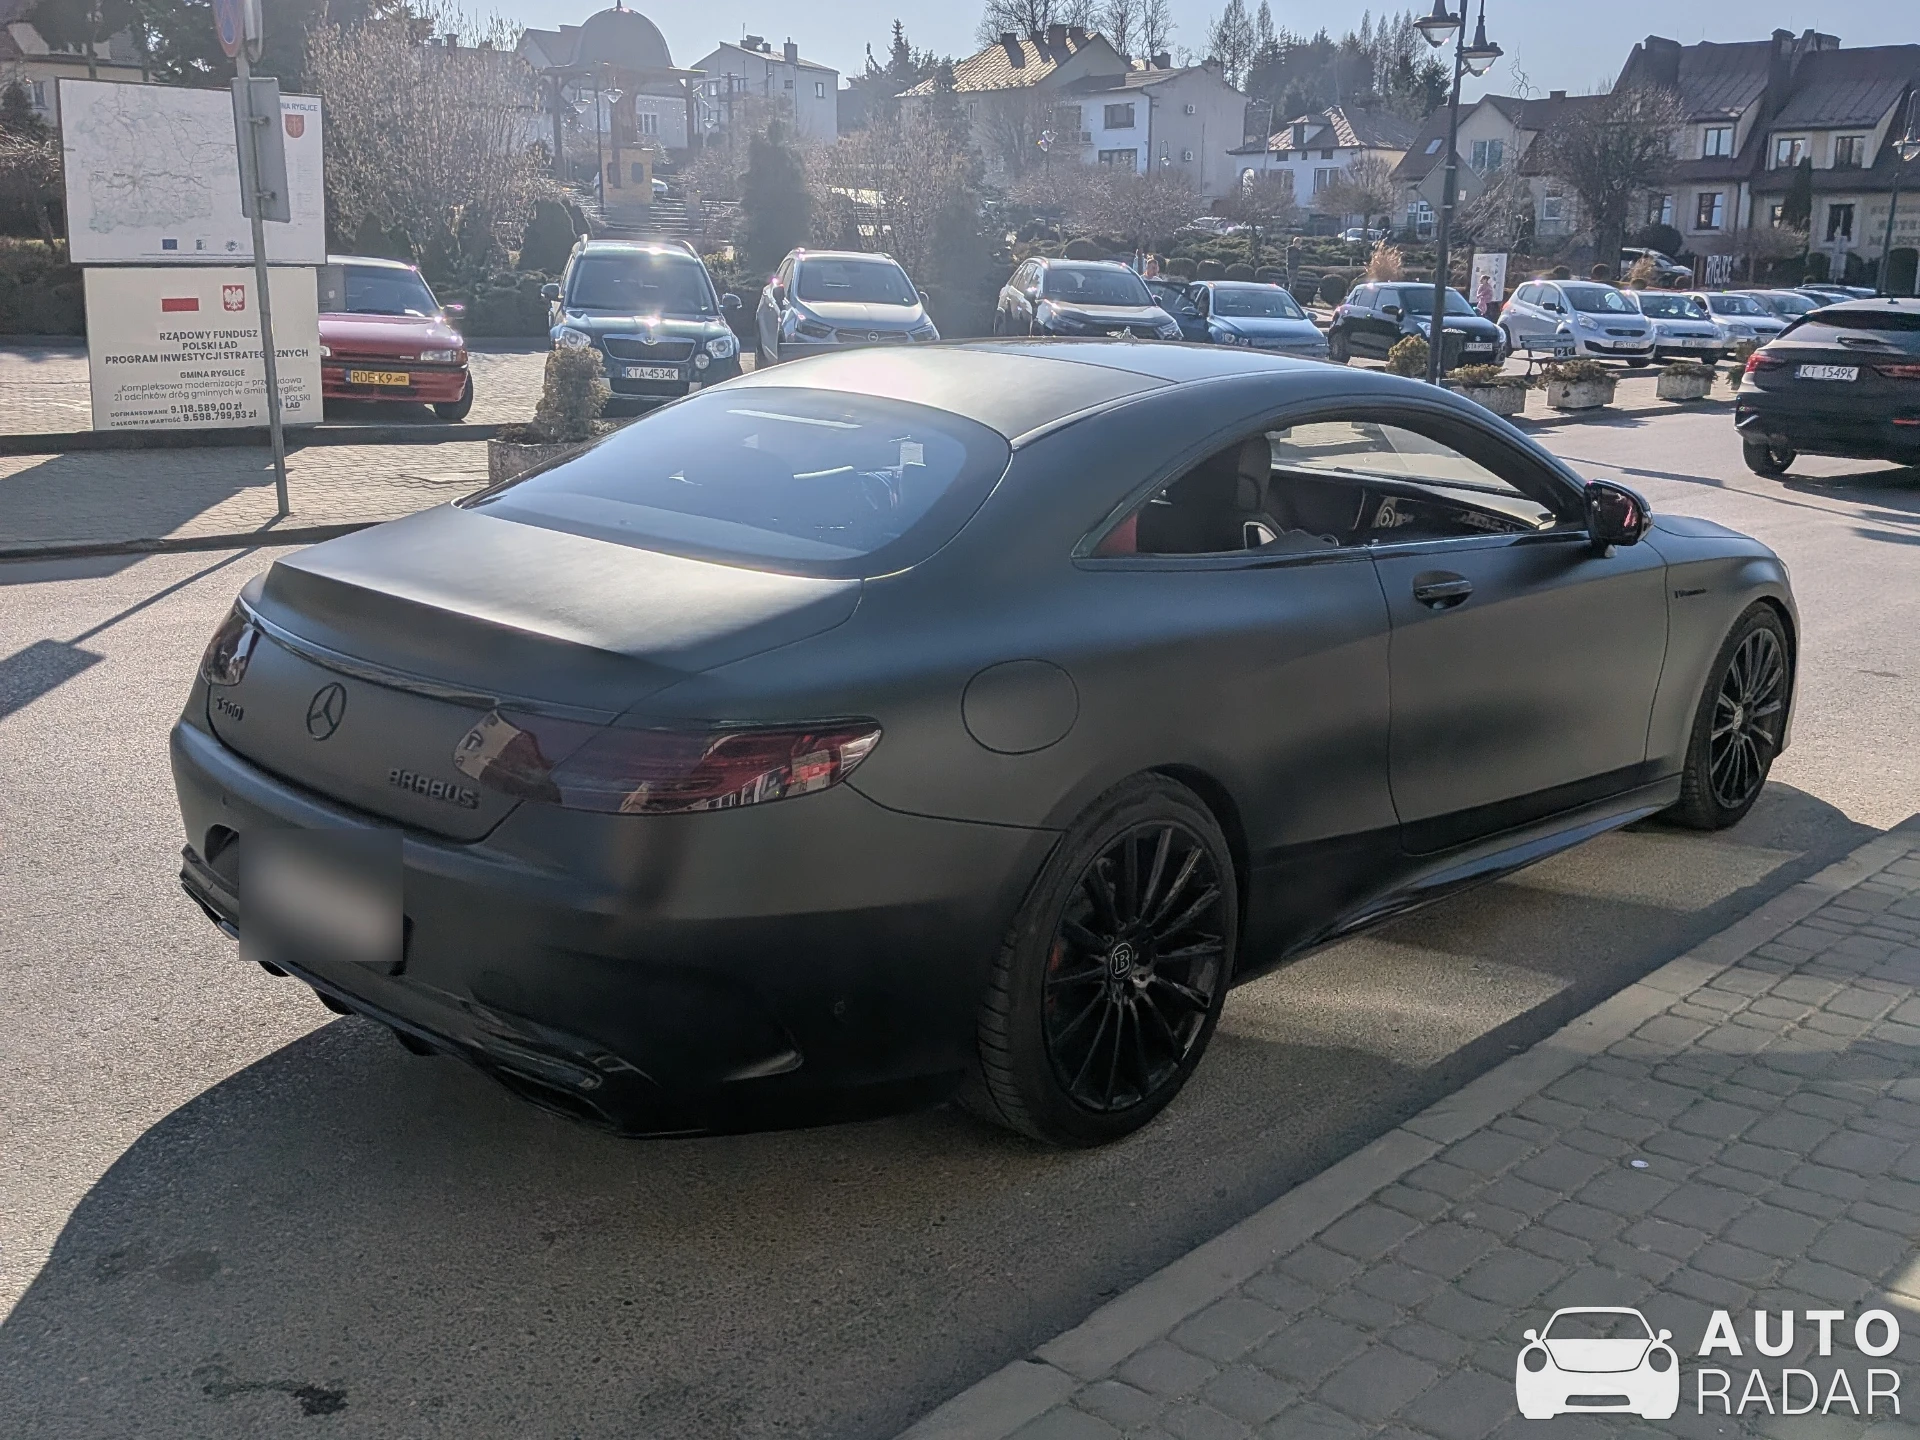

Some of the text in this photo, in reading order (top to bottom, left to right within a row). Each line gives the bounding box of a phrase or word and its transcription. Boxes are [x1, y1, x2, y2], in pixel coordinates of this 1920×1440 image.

[159, 329, 258, 342] RZĄDOWY FUNDUSZ
[182, 341, 238, 350] POLSKI ŁAD
[105, 349, 309, 364] PROGRAM INWESTYCJI STRATEGZNYCH
[180, 369, 246, 379] GMINA RYGLICE
[352, 371, 393, 384] RDE K9
[626, 367, 677, 379] KTA 4534K
[1802, 366, 1855, 379] KT 1549K
[184, 379, 243, 388] modernizacja
[114, 393, 123, 402] 21
[124, 391, 167, 401] odcinków
[168, 389, 189, 400] dróg
[191, 387, 234, 399] gminnych
[285, 394, 311, 402] POLSKI
[170, 402, 233, 413] 9.118.589,00
[234, 401, 242, 410] zł
[248, 409, 257, 418] zł
[388, 767, 478, 810] BRABUS
